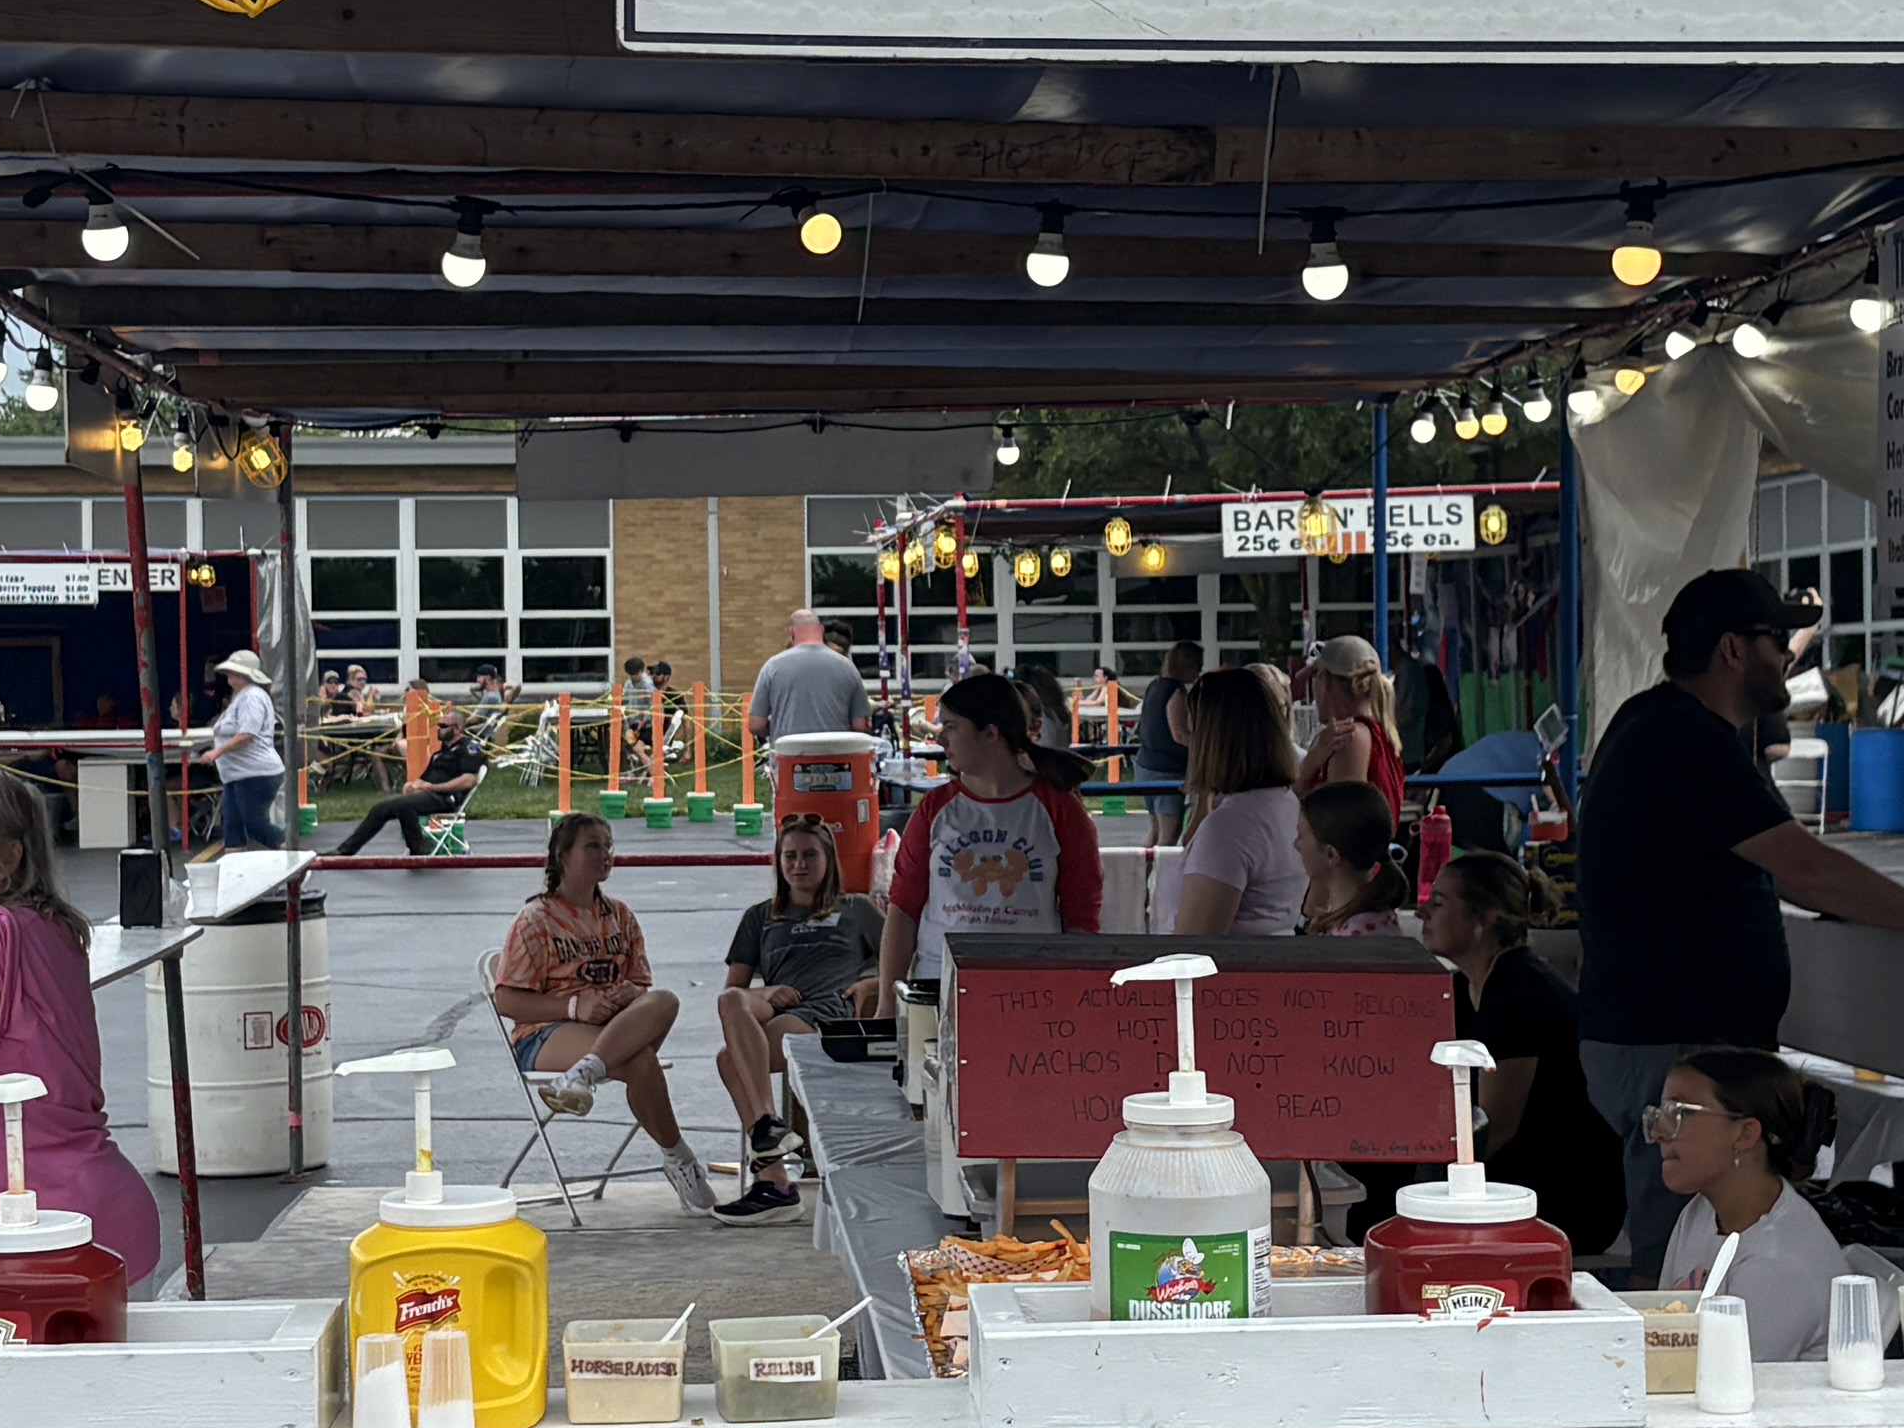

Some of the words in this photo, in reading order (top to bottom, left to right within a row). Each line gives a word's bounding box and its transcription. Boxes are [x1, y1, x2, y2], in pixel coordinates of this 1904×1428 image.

[1233, 508, 1300, 532] BAR
[1237, 534, 1281, 553] 25¢
[1371, 531, 1414, 549] 5¢
[1423, 531, 1460, 547] ea.
[97, 568, 176, 586] ENER
[938, 829, 1008, 878] BALLOON
[1012, 837, 1044, 882] CLUB
[991, 989, 1054, 1014] THIS
[1201, 988, 1261, 1009] DOES
[1283, 989, 1334, 1010] NOT
[1354, 992, 1436, 1018] BELONG
[1044, 1020, 1076, 1040] TO
[1117, 1018, 1168, 1041] HOT
[1213, 1018, 1279, 1041] DOGS
[1323, 1020, 1365, 1039] BUT
[1007, 1049, 1121, 1078] NACHOS
[1227, 1051, 1286, 1076] NOT
[1323, 1054, 1396, 1078] KNOW
[1276, 1093, 1342, 1119] READ
[398, 1294, 457, 1322] French's
[1451, 1295, 1492, 1309] HEINZ
[570, 1358, 678, 1377] HORSERADISH
[754, 1360, 817, 1378] RELISH
